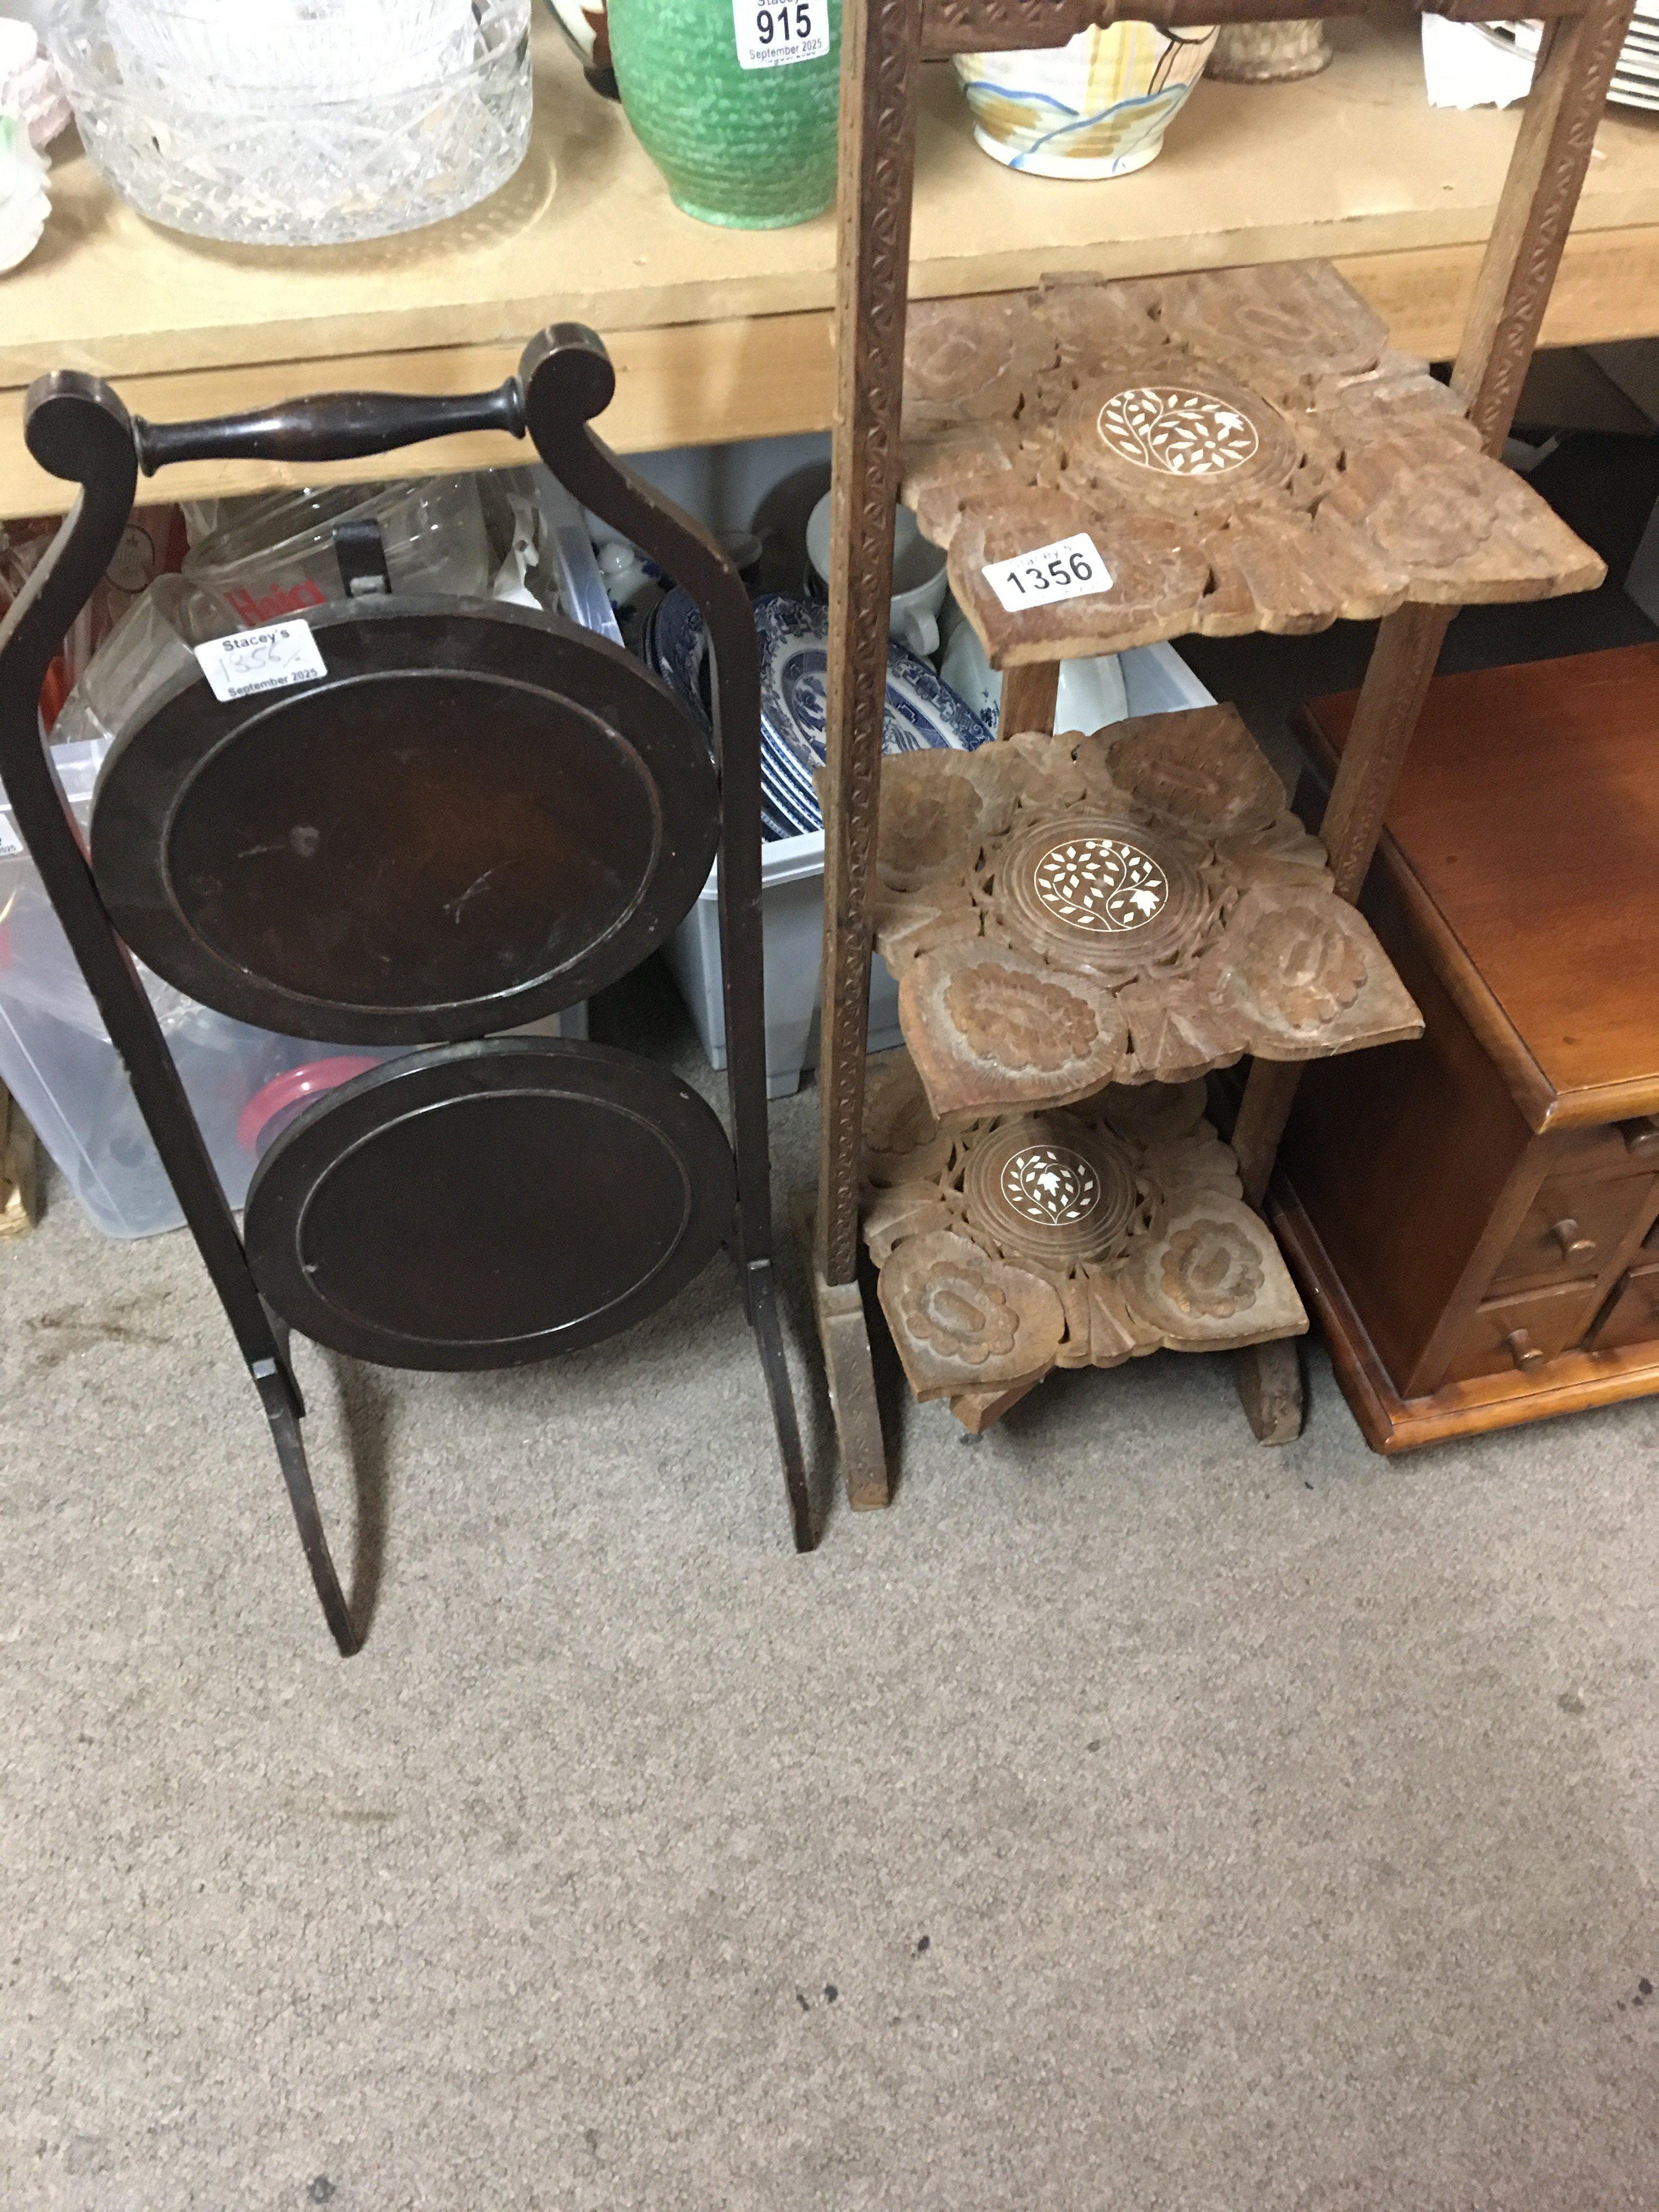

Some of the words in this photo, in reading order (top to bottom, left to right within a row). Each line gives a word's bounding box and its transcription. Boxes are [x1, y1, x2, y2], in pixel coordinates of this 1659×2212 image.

[757, 3, 811, 44] 915
[749, 46, 799, 60] September
[802, 38, 822, 52] 2025
[1007, 552, 1092, 593] 1356
[222, 629, 290, 651] Stacey's
[228, 675, 288, 697] September
[291, 668, 318, 681] 2025
